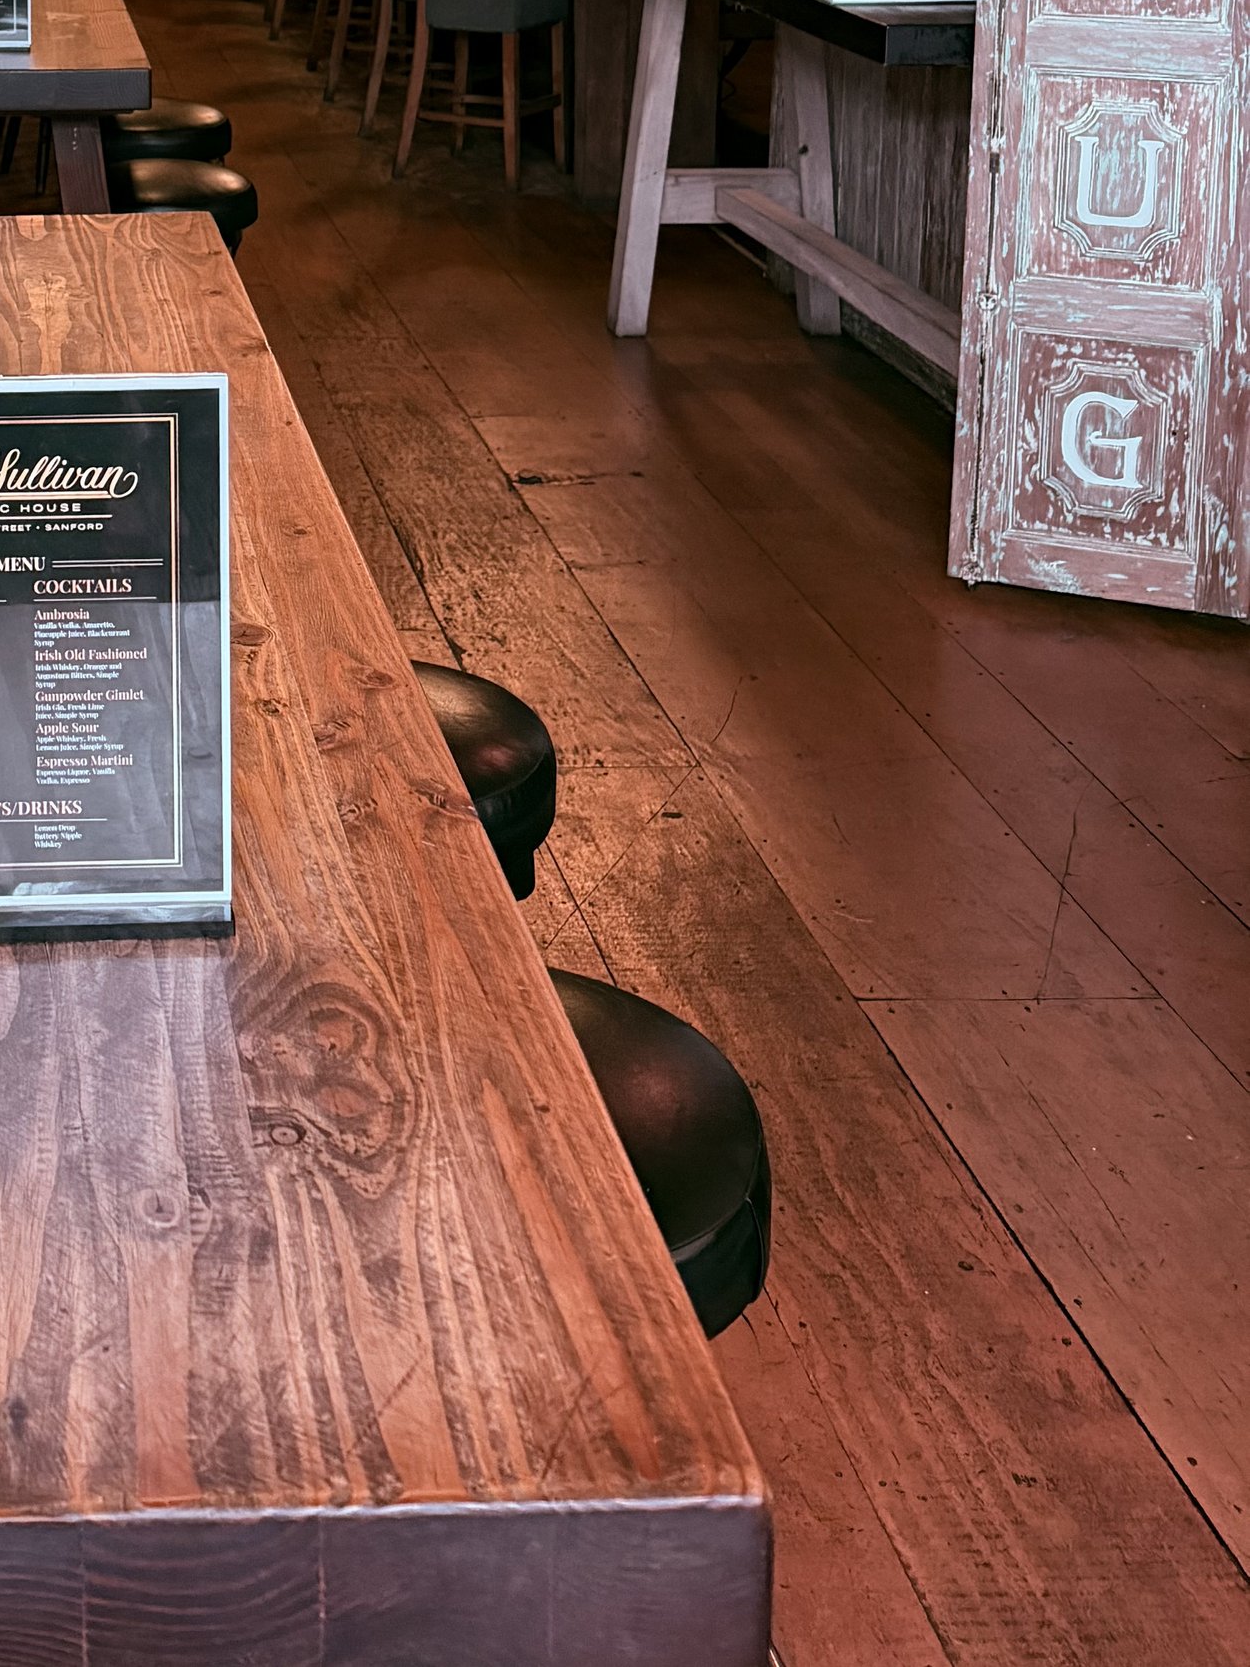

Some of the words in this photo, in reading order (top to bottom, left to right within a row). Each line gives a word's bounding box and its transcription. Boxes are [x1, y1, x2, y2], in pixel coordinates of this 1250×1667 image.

[20, 502, 82, 514] HOUSE
[46, 522, 103, 531] SANFORD
[34, 578, 132, 594] COCKTAILS
[34, 608, 89, 621] Ambrosia
[35, 649, 61, 661] Irish
[65, 648, 85, 661] Old
[89, 647, 147, 660] Fashioned
[35, 690, 103, 704] Gunpowder
[106, 688, 144, 701] Gimlet
[36, 721, 68, 735] Apple
[72, 722, 99, 733] Sour
[36, 756, 87, 769] Espresso
[91, 754, 132, 766] Martini
